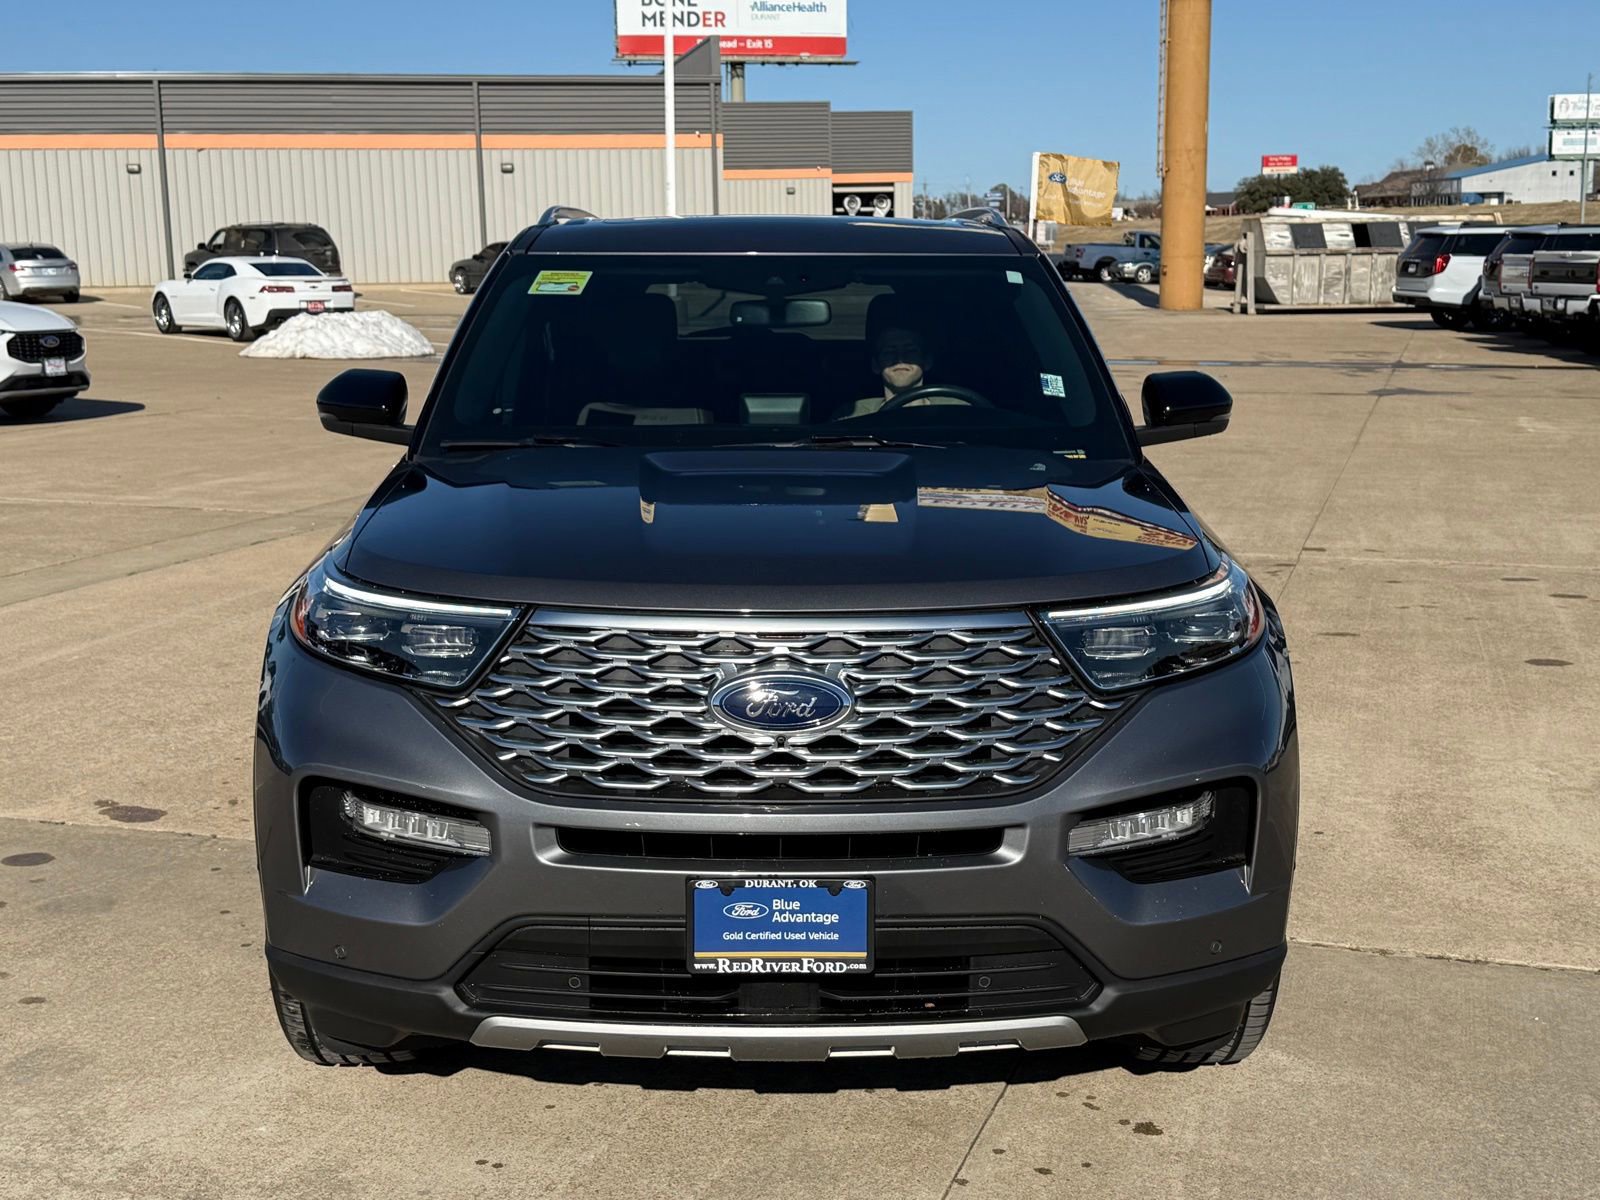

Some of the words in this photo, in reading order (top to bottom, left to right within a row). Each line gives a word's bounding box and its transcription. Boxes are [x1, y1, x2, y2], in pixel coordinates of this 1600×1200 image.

[750, 1, 827, 13] AllianceHealth
[750, 13, 781, 21] DURANT
[746, 39, 763, 49] Exit
[763, 39, 773, 49] 15
[745, 688, 818, 718] Ford
[744, 879, 797, 888] DURANT,
[799, 879, 818, 888] OK
[731, 904, 761, 916] Ford
[772, 898, 801, 910] Blue
[771, 911, 840, 925] Advantage
[722, 931, 743, 940] Gold
[745, 931, 782, 940] Certified
[783, 931, 806, 940] Used
[808, 931, 840, 940] Vehicle
